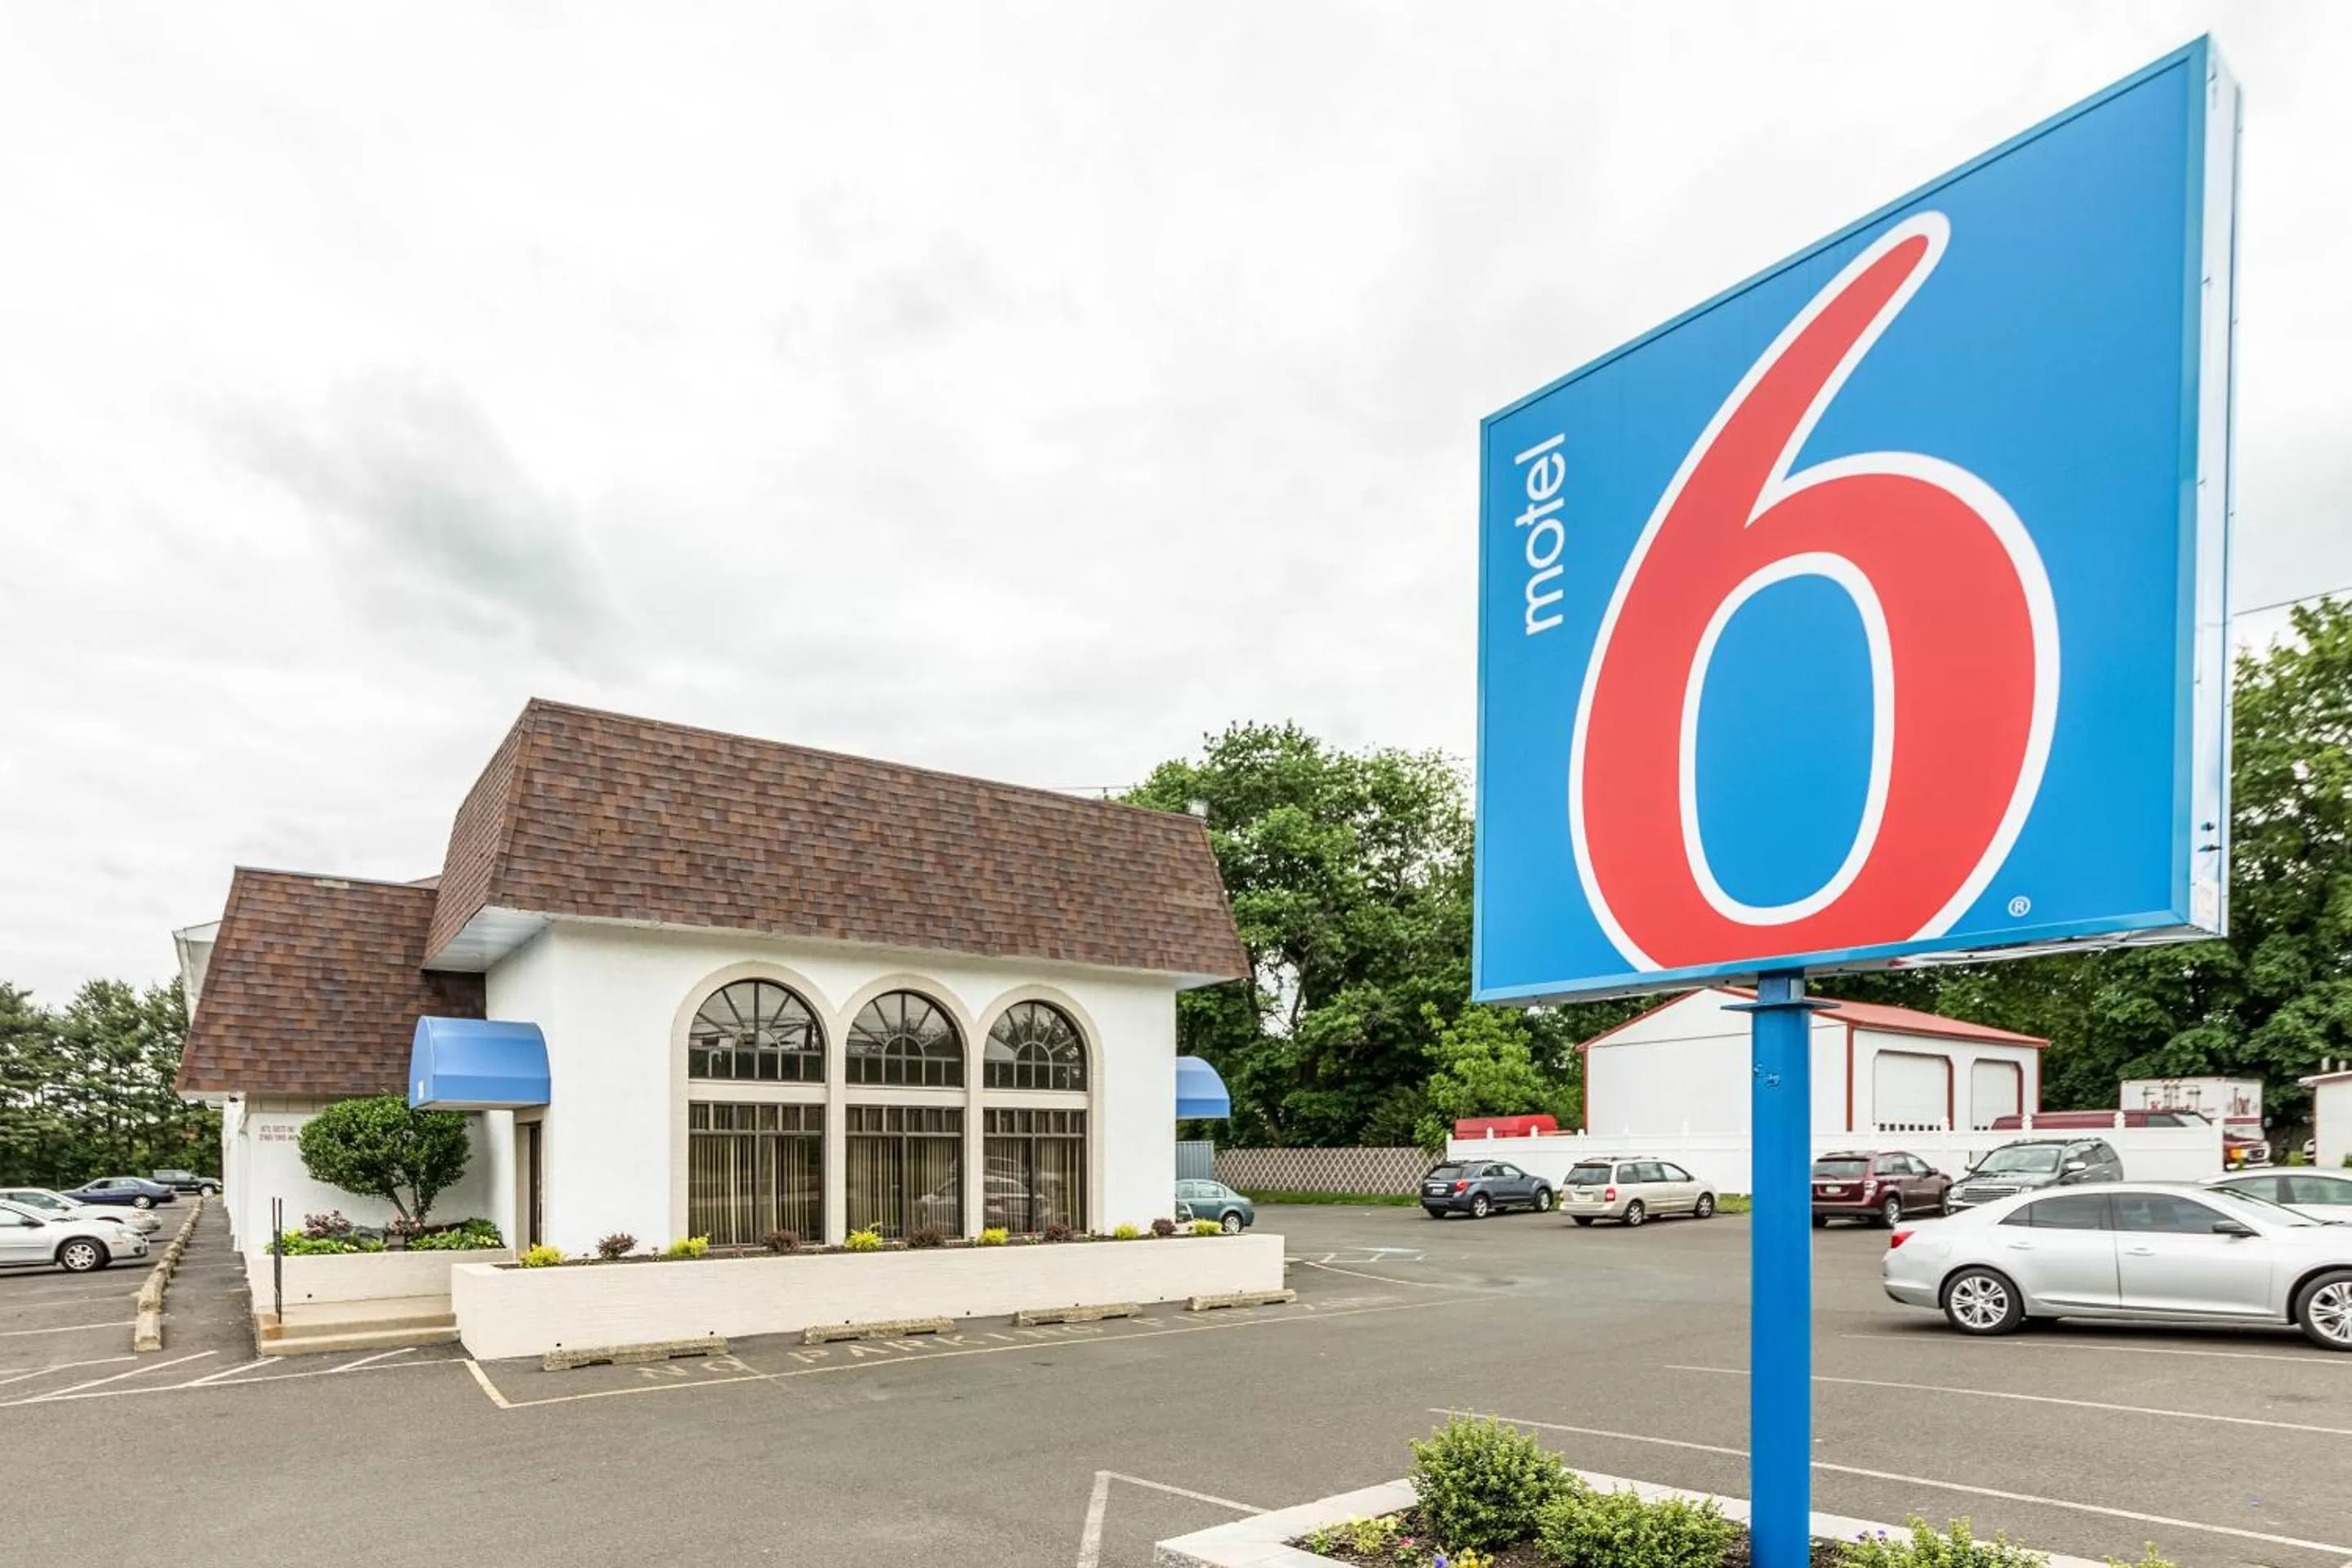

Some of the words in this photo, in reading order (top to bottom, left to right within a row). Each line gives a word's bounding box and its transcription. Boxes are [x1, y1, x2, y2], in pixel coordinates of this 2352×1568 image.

[1515, 433, 1566, 635] motel
[1568, 210, 2060, 973] 6
[635, 1360, 745, 1379] NO
[786, 1325, 1105, 1364] PARKING
